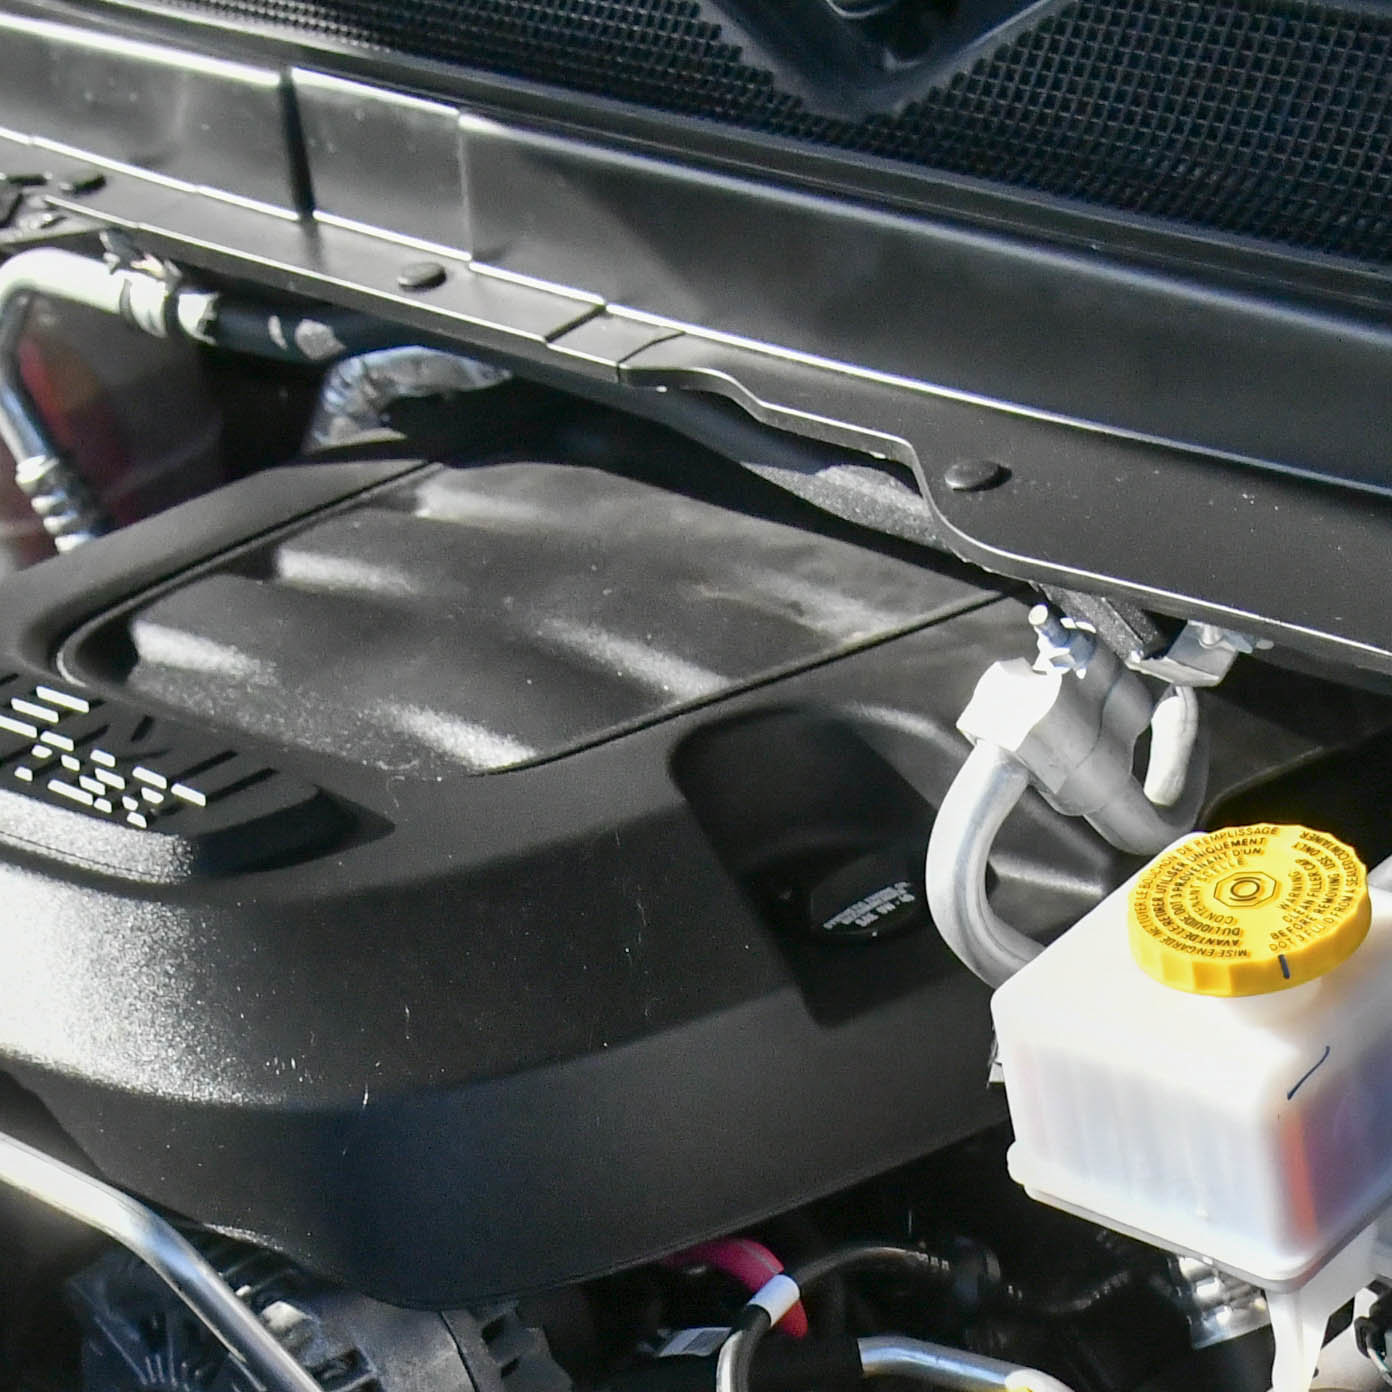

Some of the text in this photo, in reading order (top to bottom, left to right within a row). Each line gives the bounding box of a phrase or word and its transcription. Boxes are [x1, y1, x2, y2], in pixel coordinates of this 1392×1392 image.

[1193, 827, 1279, 847] REMPLISSAGE
[1187, 837, 1265, 863] UNIQUEMENT
[1282, 899, 1314, 923] CLEAN
[1270, 916, 1317, 940] BEFORE
[1200, 937, 1240, 947] AVANT
[1269, 938, 1295, 952] DOT
